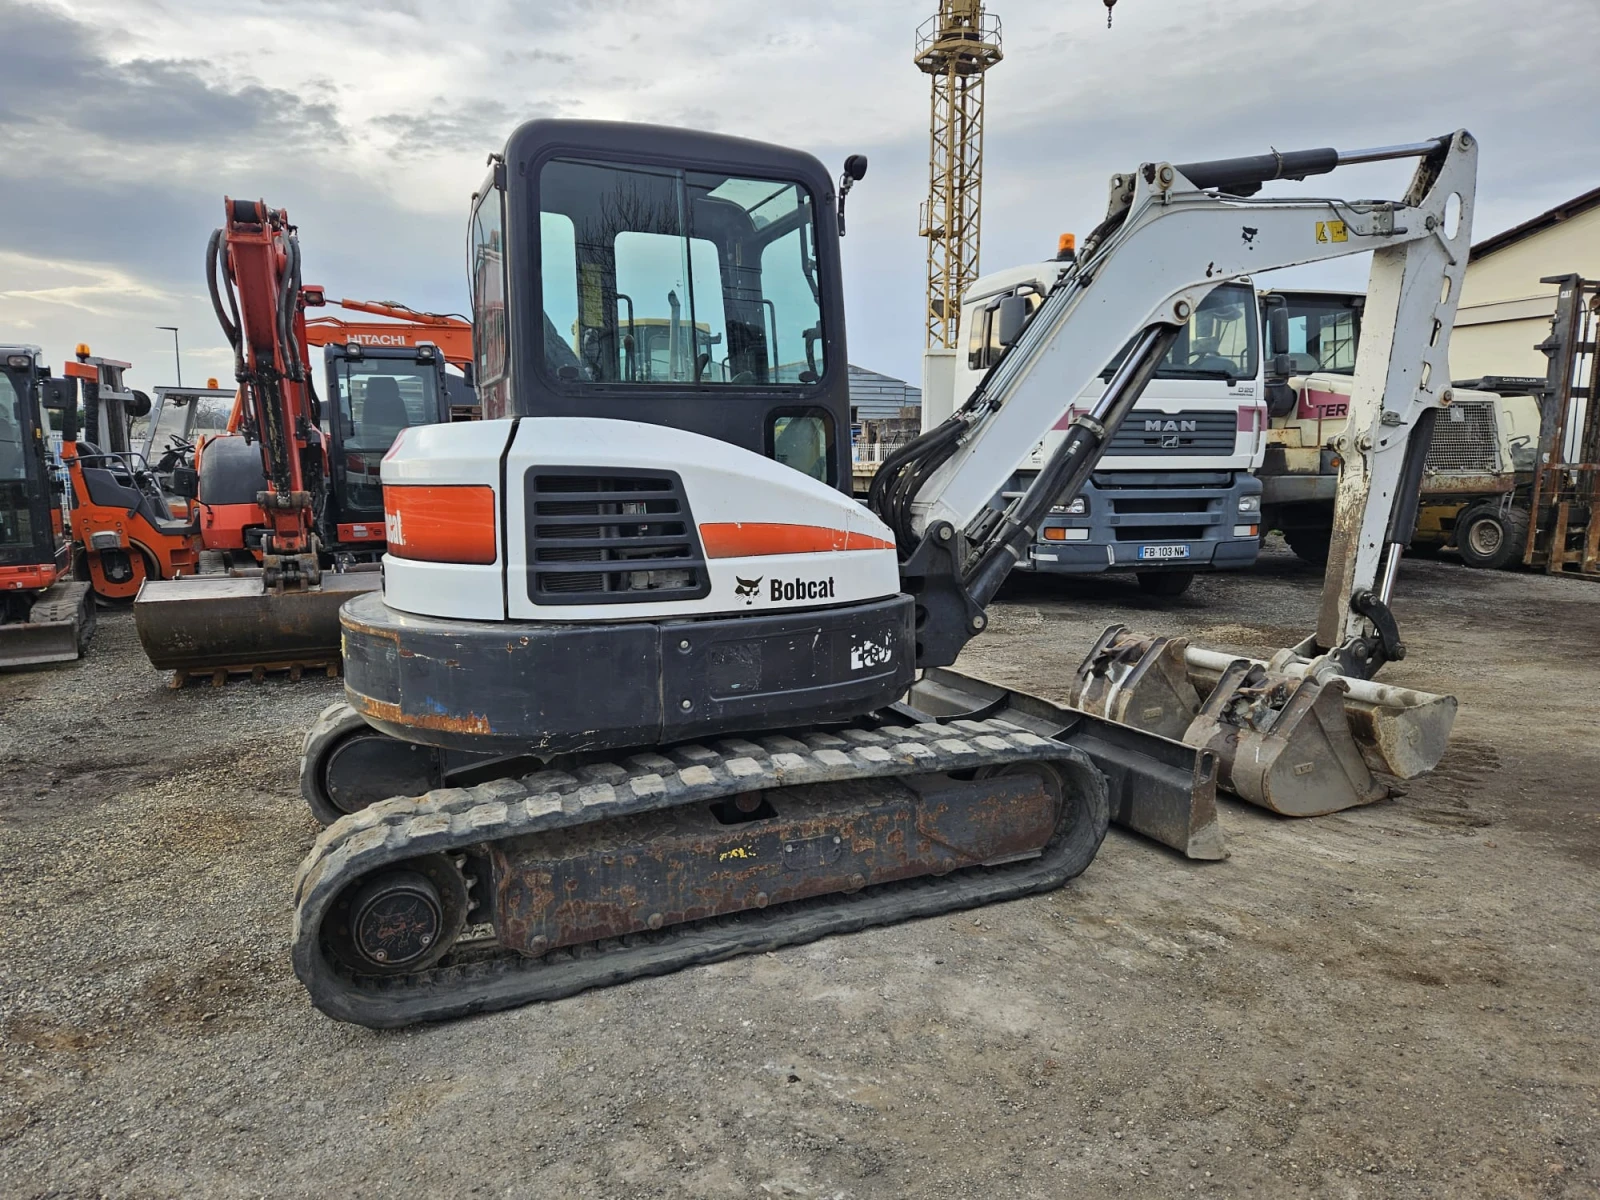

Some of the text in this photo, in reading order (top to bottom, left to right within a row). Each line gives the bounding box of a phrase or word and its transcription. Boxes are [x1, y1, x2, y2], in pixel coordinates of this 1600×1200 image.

[1560, 290, 1572, 299] CAT
[346, 334, 405, 346] HITACHI
[1145, 420, 1196, 432] MAN
[770, 577, 835, 602] Bobcat
